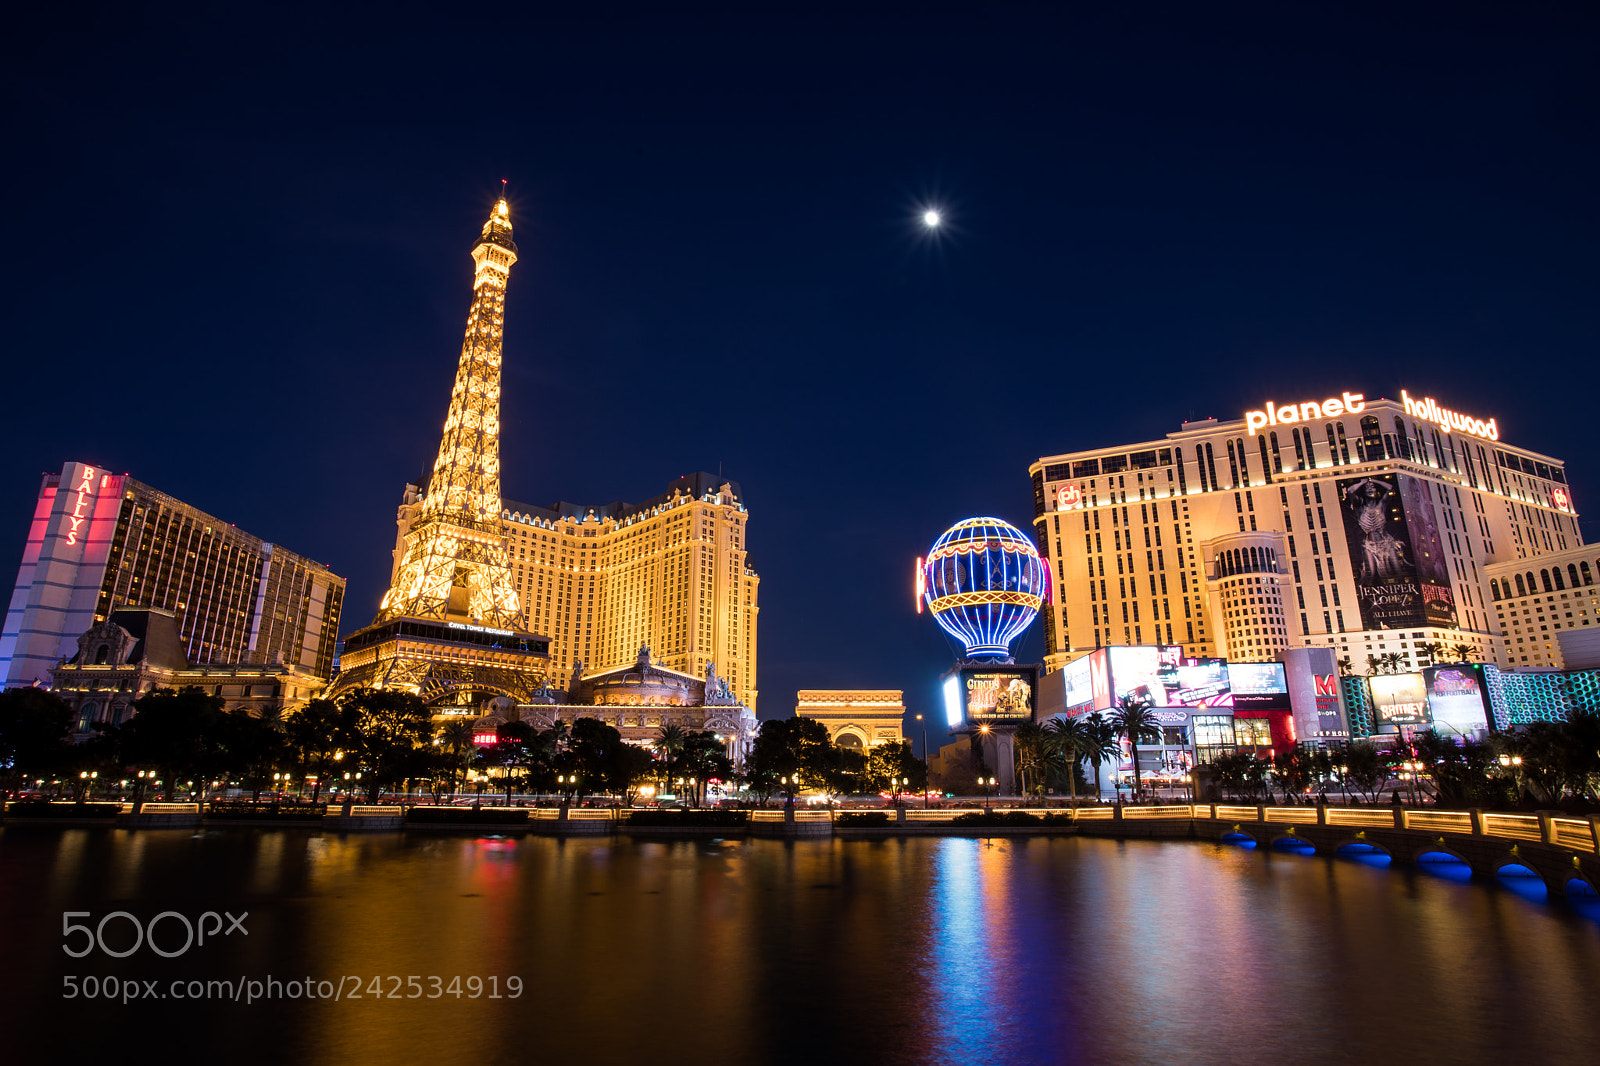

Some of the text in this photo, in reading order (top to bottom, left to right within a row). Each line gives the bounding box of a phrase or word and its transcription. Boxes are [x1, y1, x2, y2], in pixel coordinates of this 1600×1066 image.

[1245, 391, 1366, 436] planet
[1401, 389, 1499, 441] hollywood
[1359, 583, 1419, 600] JENNIFER
[1421, 583, 1454, 607] BRITNEY
[1372, 594, 1411, 606] LOPEZ
[466, 624, 484, 632] TOWER
[1091, 654, 1108, 698] M
[967, 679, 1000, 690] CIRCUS
[1312, 673, 1338, 697] M
[1446, 688, 1478, 696] FOOTBALL
[1066, 702, 1094, 718] MIRACLE MILE
[1380, 702, 1425, 720] BRITNEY
[1192, 716, 1227, 724] URBAN
[473, 734, 498, 744] BEER
